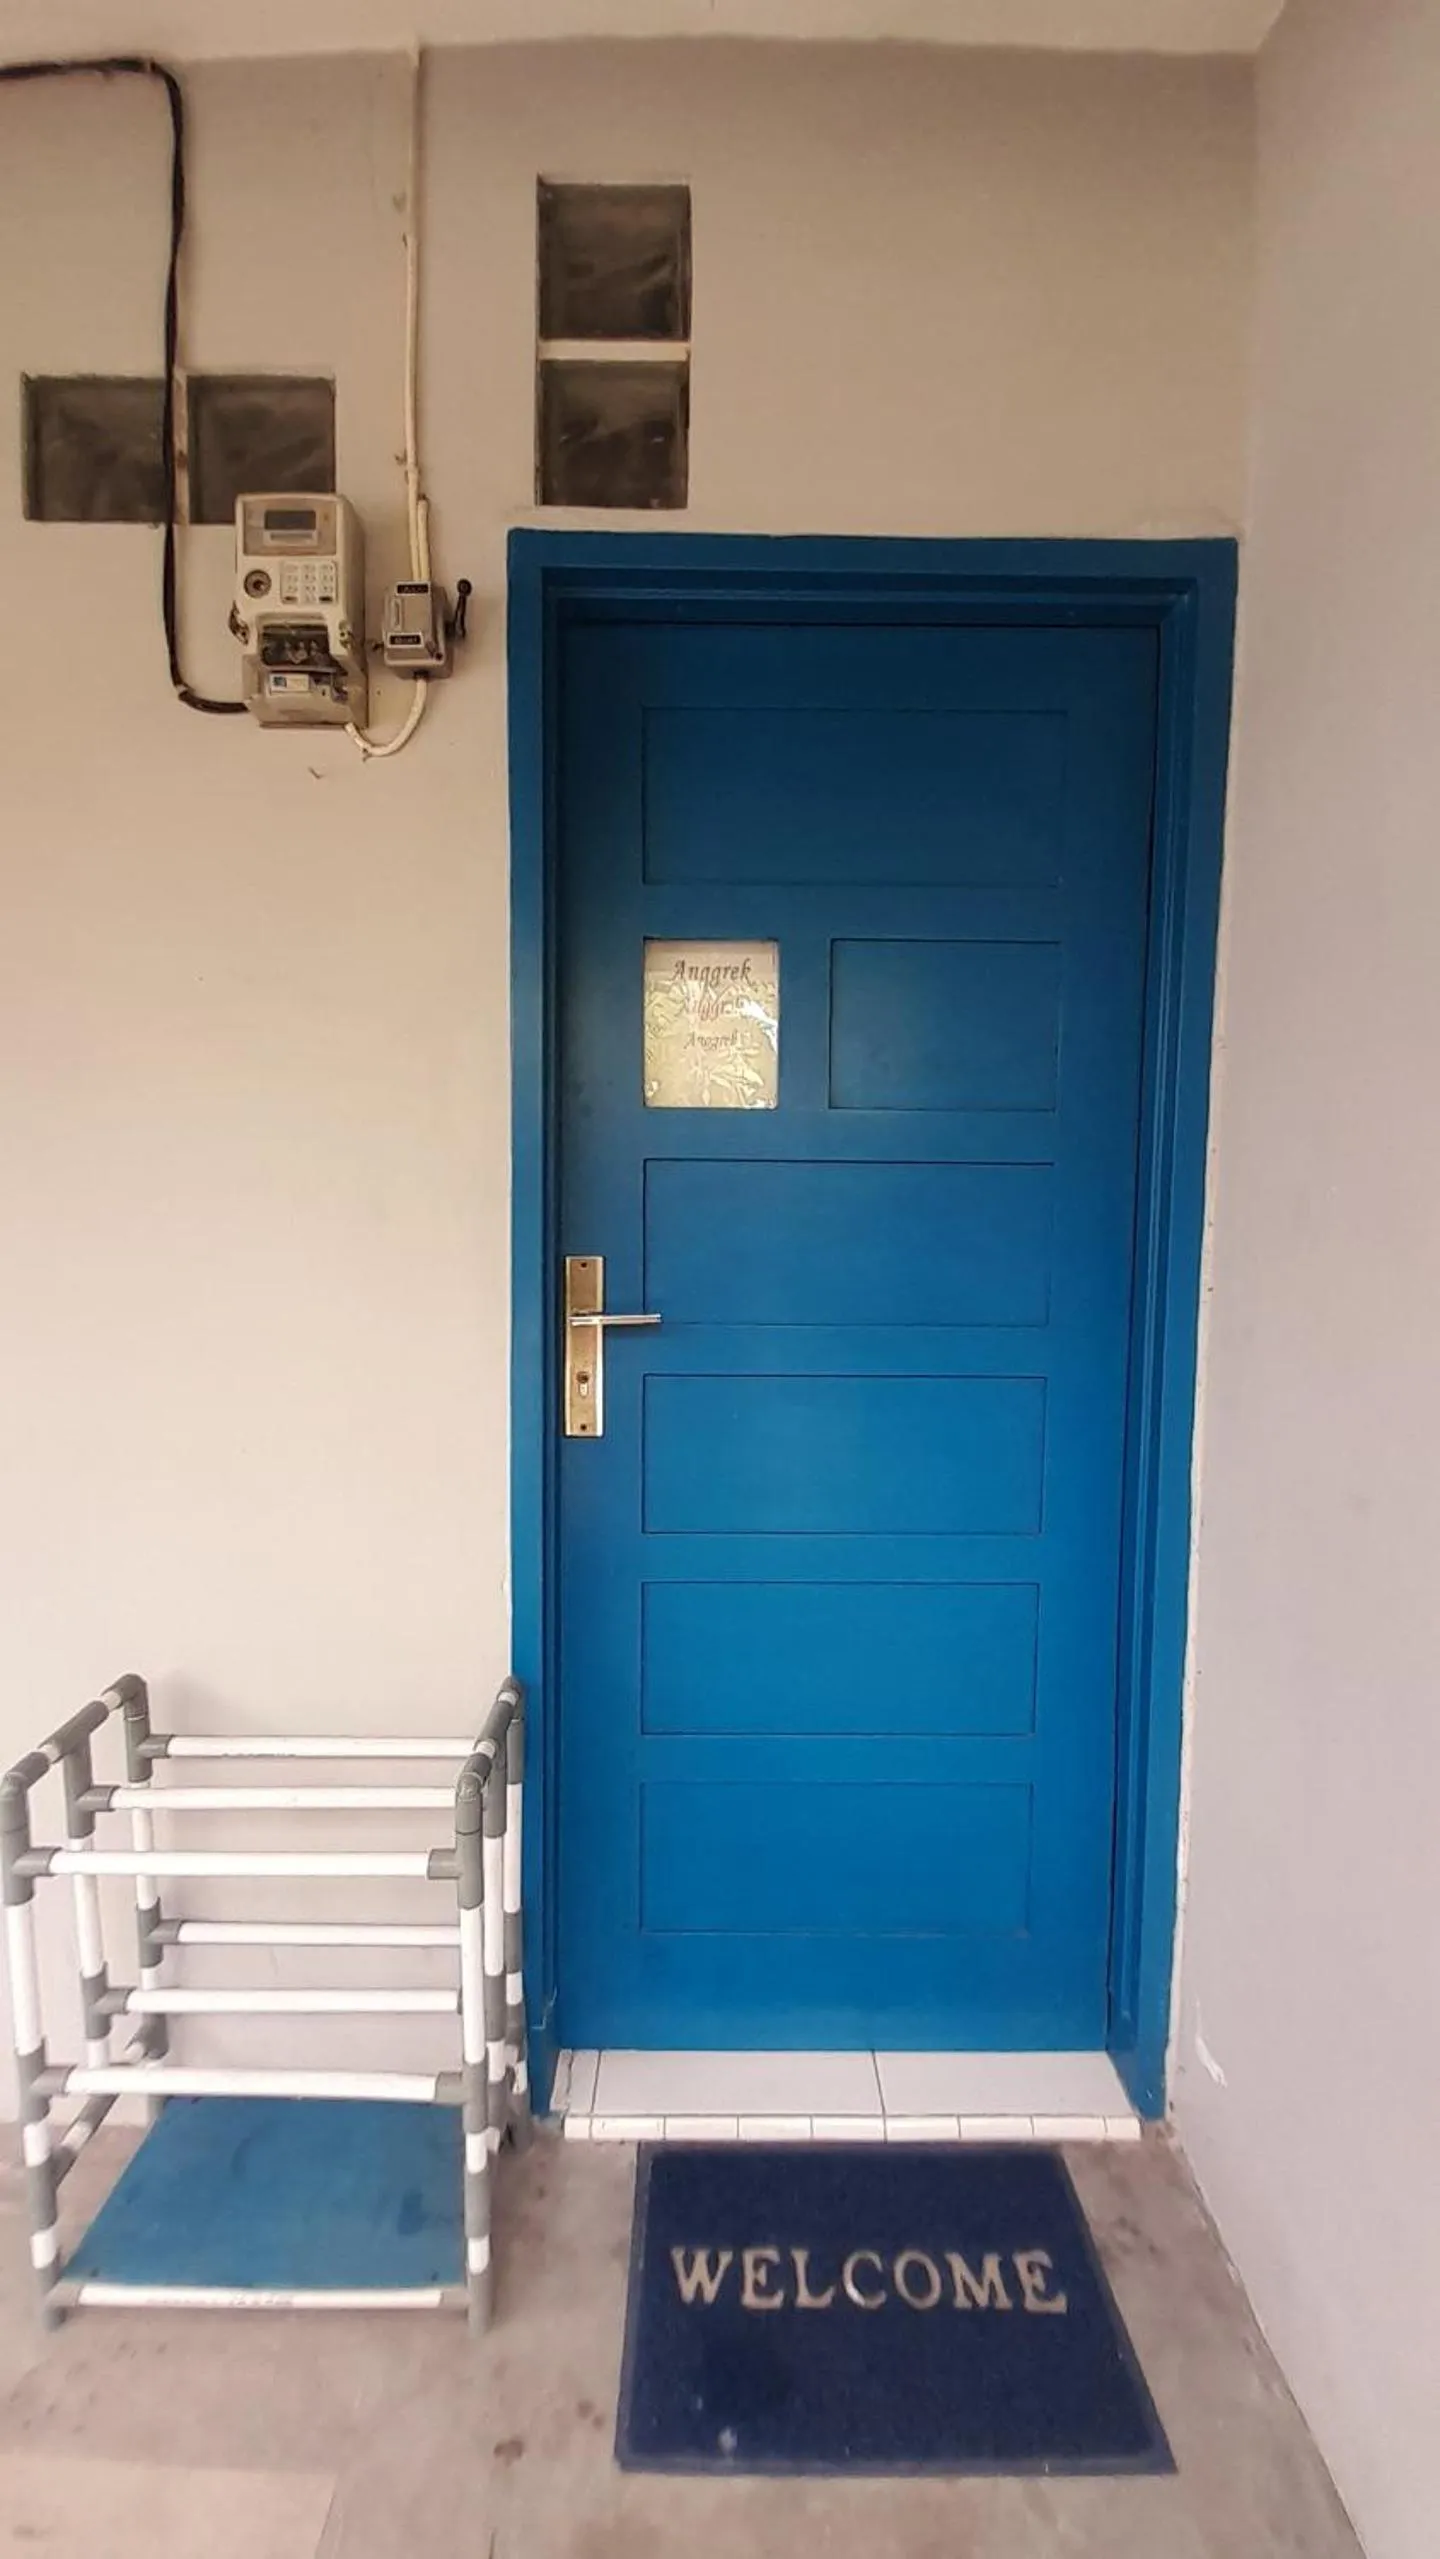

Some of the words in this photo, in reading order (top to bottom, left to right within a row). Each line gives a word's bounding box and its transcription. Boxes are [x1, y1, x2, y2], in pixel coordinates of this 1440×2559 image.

[671, 957, 756, 991] Anggrek
[675, 994, 748, 1021] Anggr
[669, 2244, 1068, 2315] WELCOME
